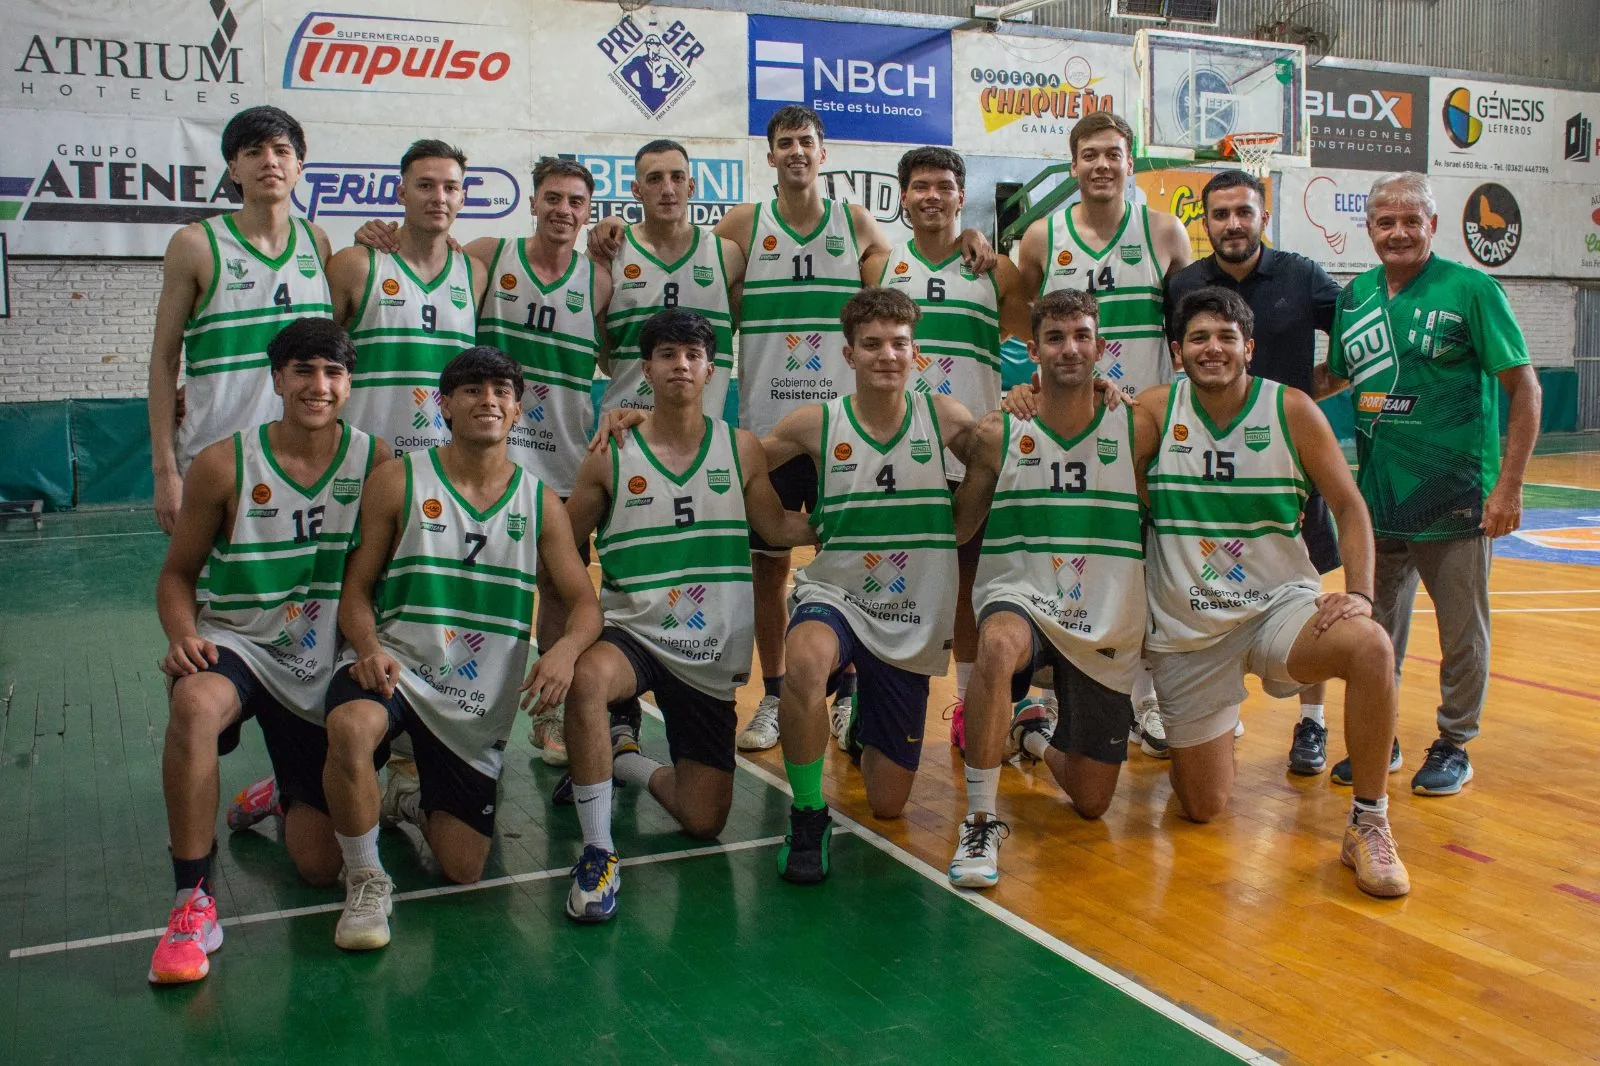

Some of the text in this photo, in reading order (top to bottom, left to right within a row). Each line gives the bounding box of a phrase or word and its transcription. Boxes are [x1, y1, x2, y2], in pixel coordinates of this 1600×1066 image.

[337, 30, 440, 43] SUPERMERCADOS
[597, 17, 643, 65] PRO
[662, 20, 705, 68] SER
[14, 34, 244, 85] ATRIUM
[813, 57, 936, 99] NBCH
[972, 68, 1059, 87] LOTERIA
[20, 82, 240, 105] HOTELES
[980, 86, 1113, 119] CHAQUEÑA
[1477, 90, 1545, 123] GÉNESIS
[813, 99, 923, 117] Este es tu banco
[1304, 89, 1403, 129] BLOX
[1311, 126, 1412, 141] ORMIGONES
[1488, 124, 1532, 136] LETREROS
[57, 143, 138, 159] GRUPO
[1309, 140, 1412, 155] ONSTRUCTORA
[1444, 160, 1461, 168] Israel
[1463, 161, 1474, 169] 650
[34, 158, 244, 206] ATENEA
[493, 196, 511, 206] SRL
[1334, 193, 1369, 213] ELECT
[1465, 221, 1520, 263] BALCARCE
[792, 254, 816, 282] 11
[1085, 266, 1116, 294] 14
[273, 283, 293, 314] 4
[663, 282, 679, 309] 8
[926, 277, 946, 303] 6
[421, 304, 437, 334] 9
[523, 302, 557, 333] 10
[770, 377, 833, 388] Gobierno de
[770, 389, 838, 400] Resistencia
[505, 435, 557, 453] esistencia
[539, 428, 554, 440] de
[1049, 461, 1087, 494] 13
[1202, 450, 1236, 482] 15
[875, 463, 897, 496] 4
[292, 505, 326, 545] 12
[673, 495, 696, 529] 5
[462, 532, 488, 567] 7
[901, 599, 917, 610] de
[1189, 585, 1260, 599] Gobierno de
[703, 636, 718, 647] de
[470, 689, 486, 703] de
